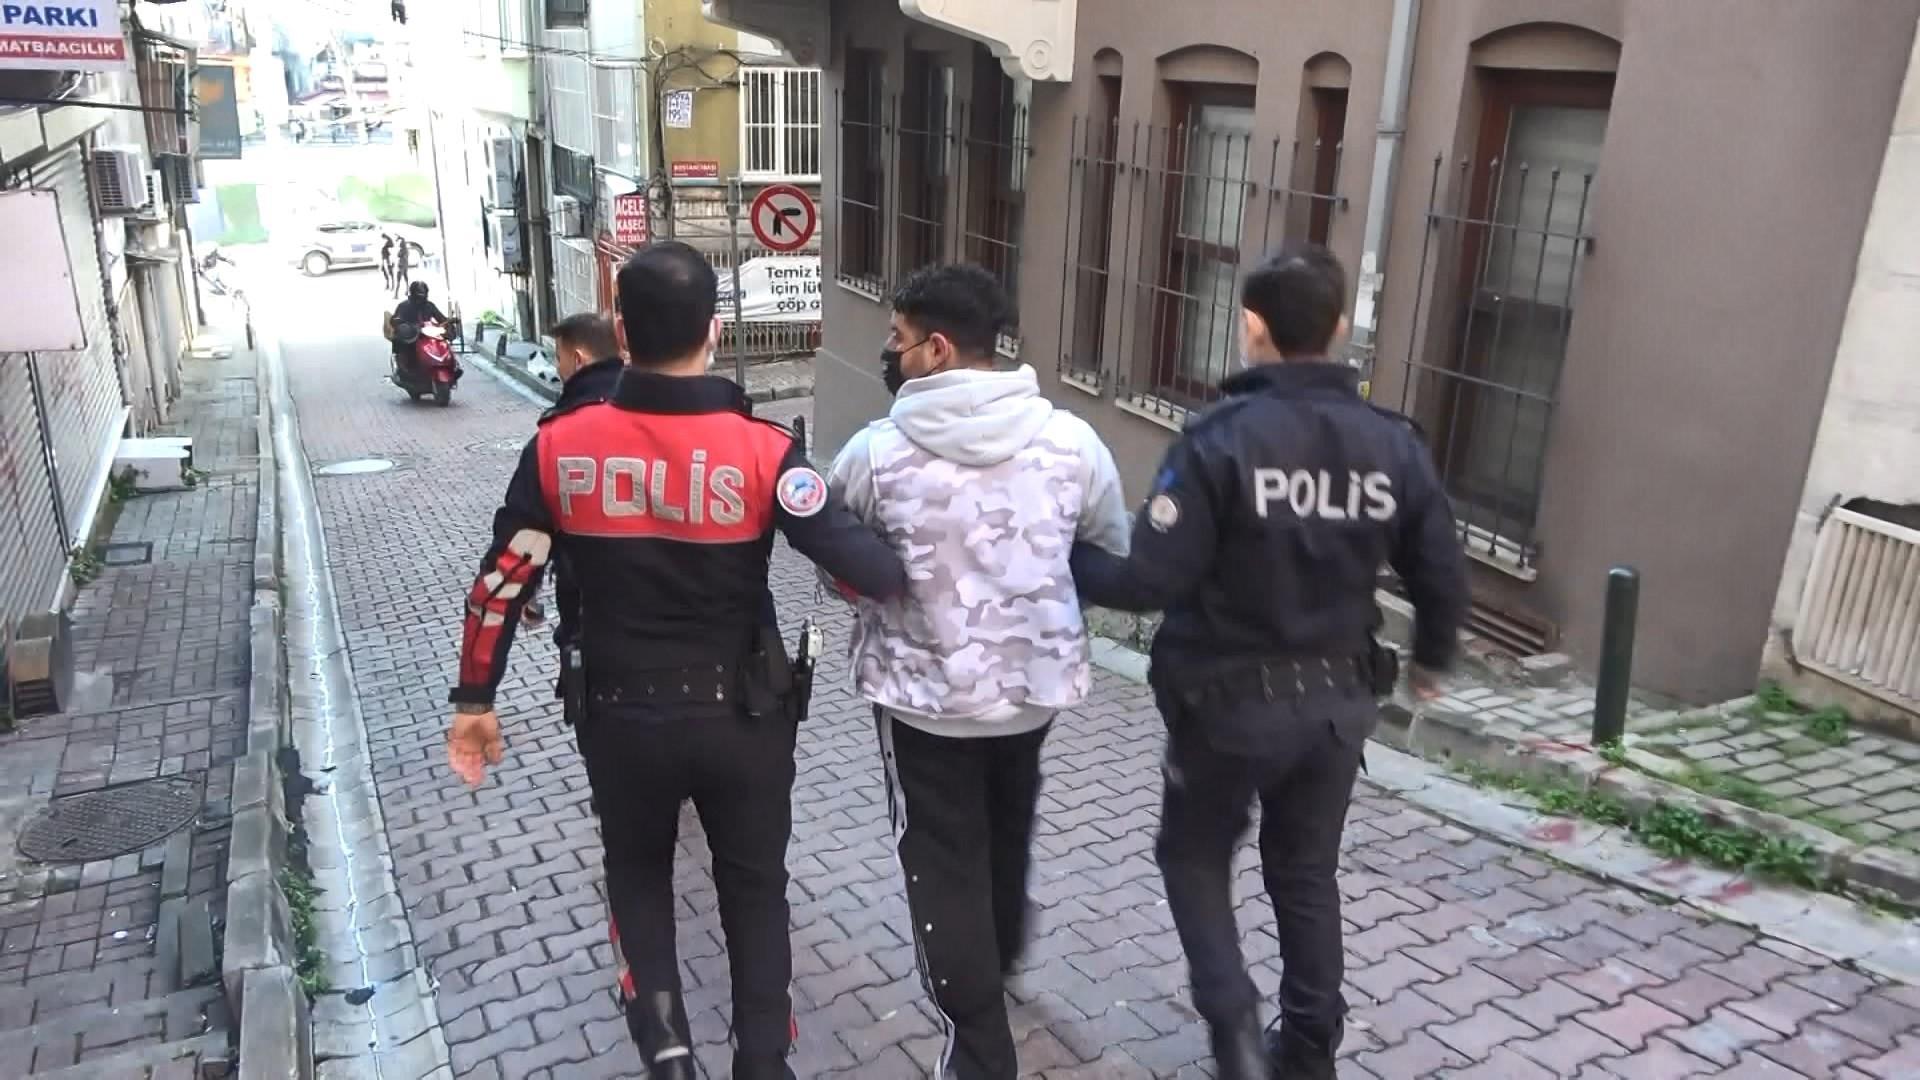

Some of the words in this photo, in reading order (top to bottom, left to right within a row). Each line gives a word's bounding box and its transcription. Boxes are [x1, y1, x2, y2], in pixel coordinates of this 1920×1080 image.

[3, 4, 98, 28] PARKI
[615, 199, 646, 217] ACELE
[765, 265, 812, 278] Temiz
[771, 280, 800, 296] için
[777, 297, 807, 313] çöp
[556, 449, 745, 526] POLİS
[1253, 467, 1397, 521] POLİS
